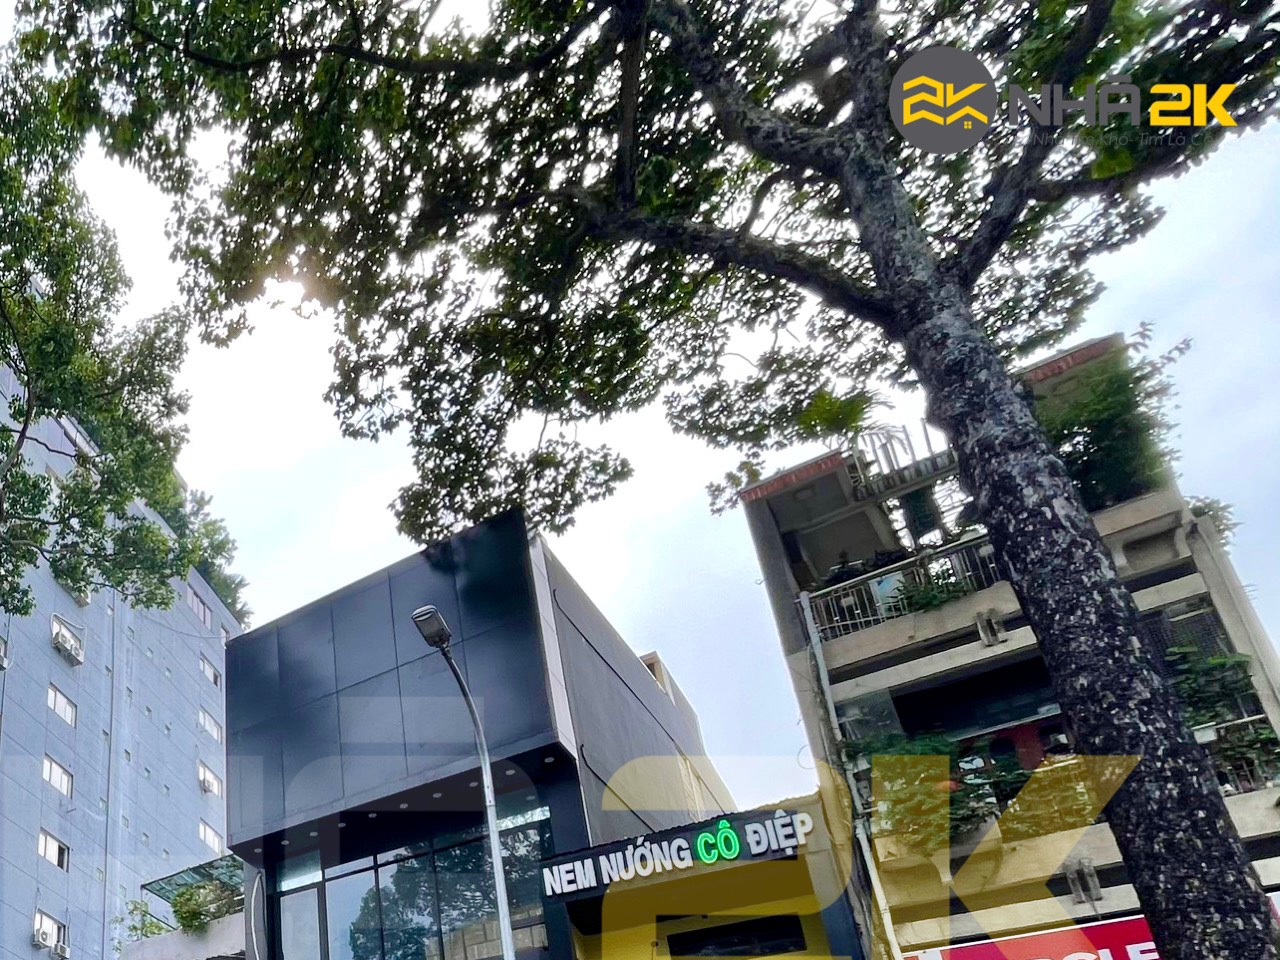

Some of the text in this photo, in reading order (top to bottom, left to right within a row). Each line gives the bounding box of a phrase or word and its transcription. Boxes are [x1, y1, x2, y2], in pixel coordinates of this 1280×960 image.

[542, 808, 814, 896] NEM NƯỚNG CÔ ĐIỆP
